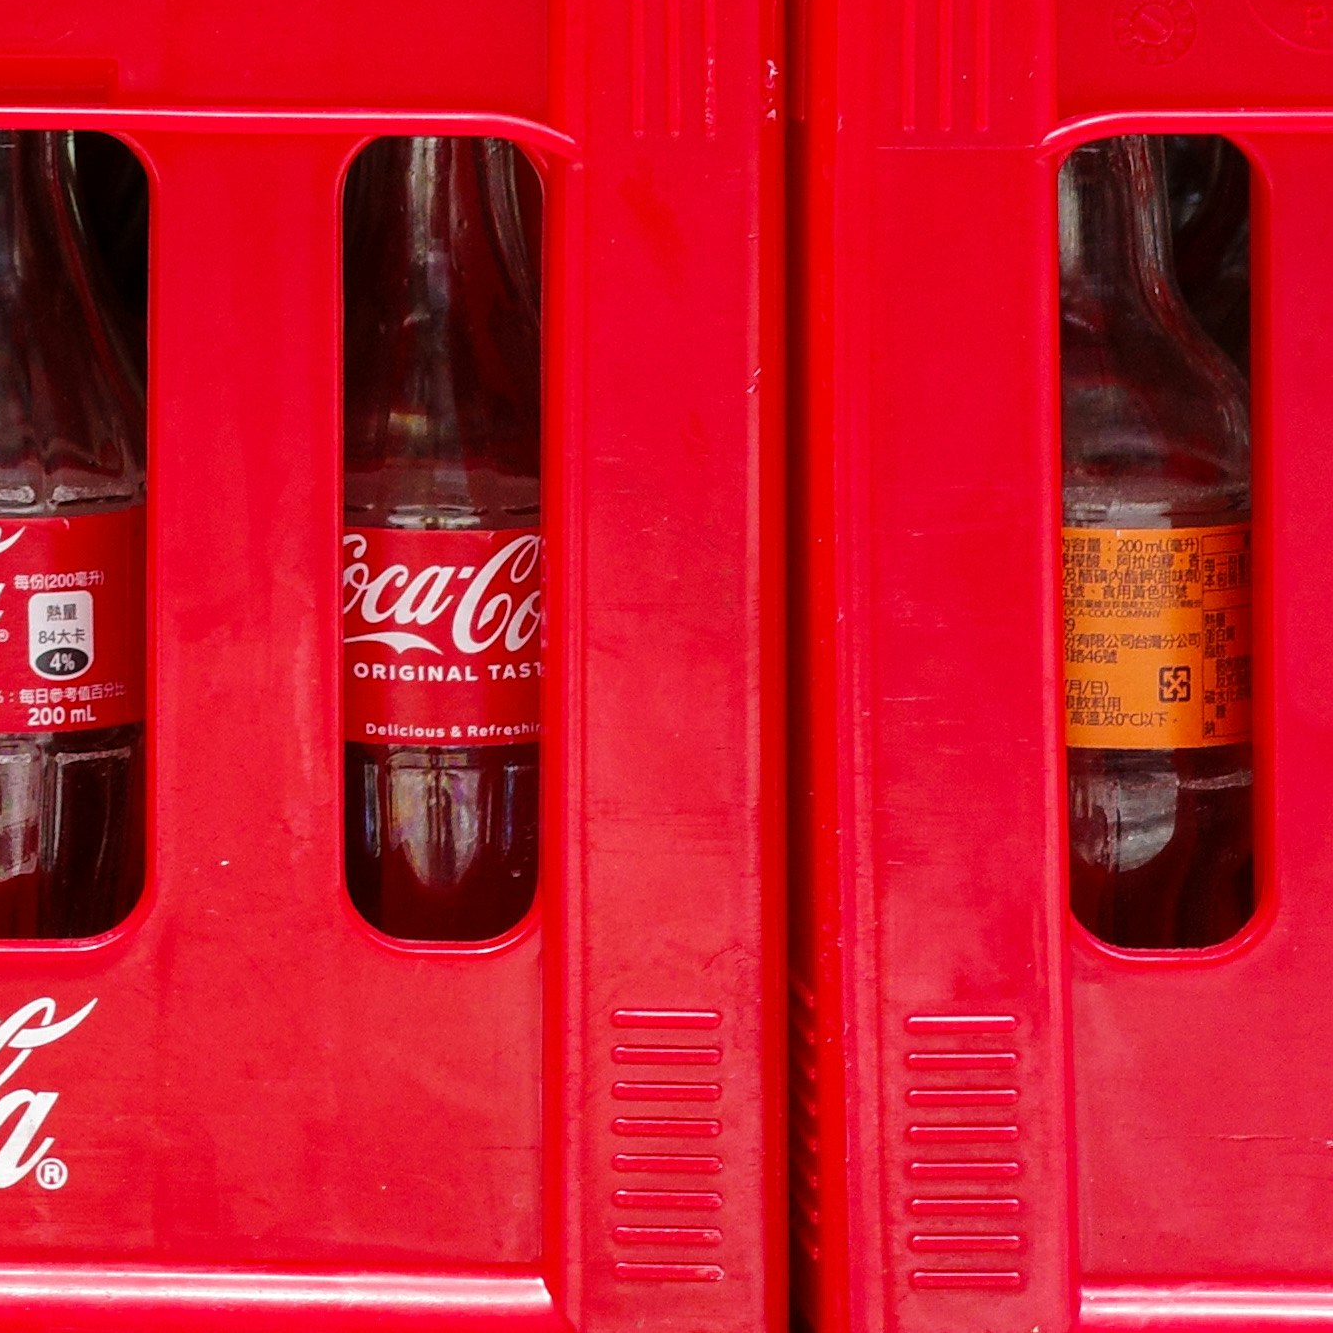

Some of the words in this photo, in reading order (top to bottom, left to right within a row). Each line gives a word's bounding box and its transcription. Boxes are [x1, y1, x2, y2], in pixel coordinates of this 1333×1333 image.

[46, 603, 78, 622] 熱量
[38, 627, 86, 645] 84大卡
[49, 651, 76, 672] 4%
[353, 662, 479, 682] ORIGINAL
[27, 707, 65, 727] 200
[70, 705, 97, 724] mL
[366, 722, 446, 738] Delicious
[449, 725, 462, 738] &
